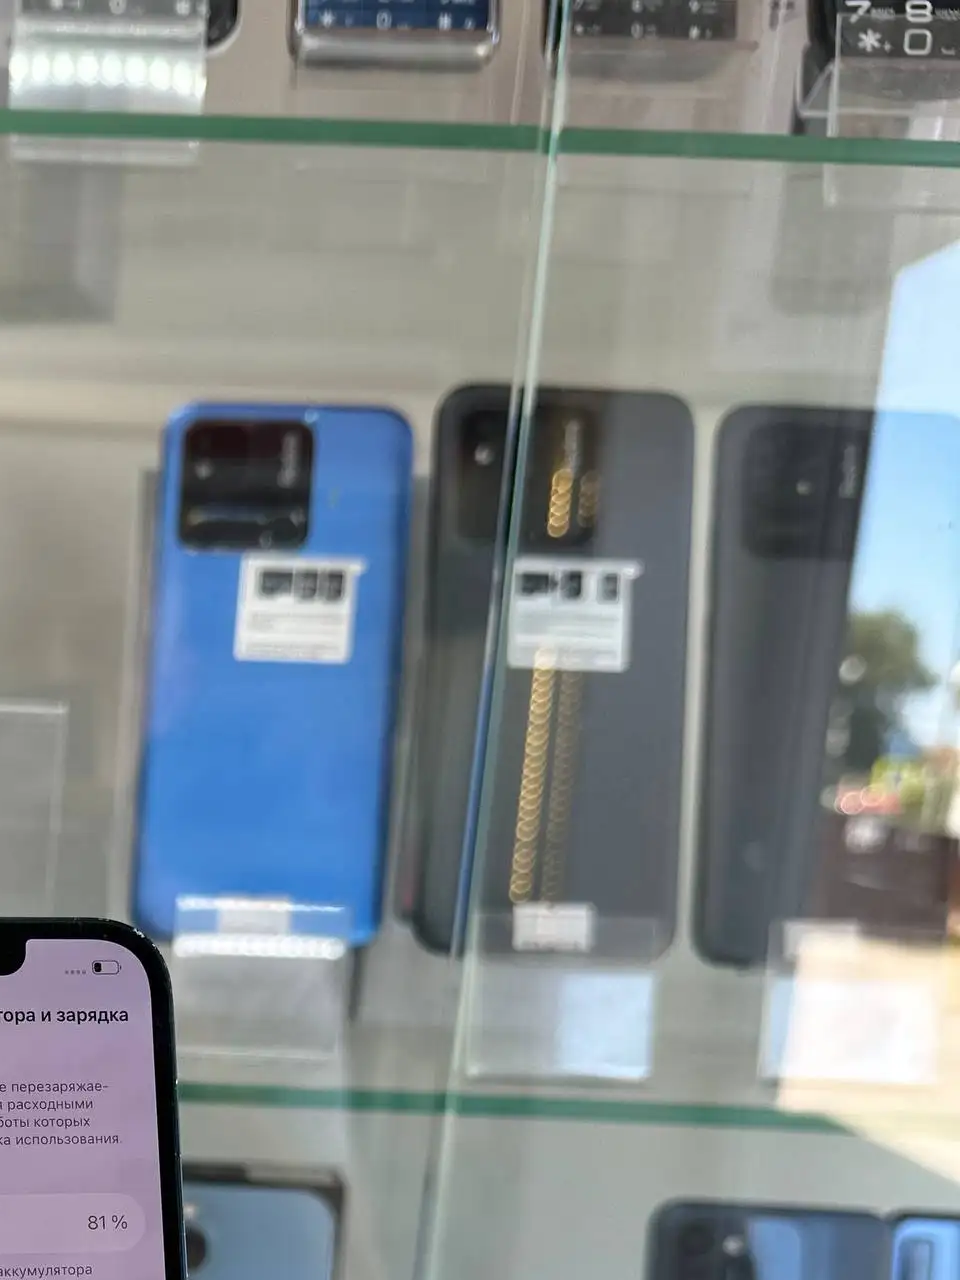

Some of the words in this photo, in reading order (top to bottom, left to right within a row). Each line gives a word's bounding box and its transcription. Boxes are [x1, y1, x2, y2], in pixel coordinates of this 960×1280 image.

[41, 1010, 52, 1022] и
[56, 1010, 129, 1025] зарядка
[11, 1082, 109, 1095] перезаряжае-
[7, 1100, 94, 1113] расходными
[33, 1117, 91, 1130] которых
[15, 1134, 122, 1146] использования.
[87, 1215, 106, 1231] 81
[111, 1214, 128, 1230] %
